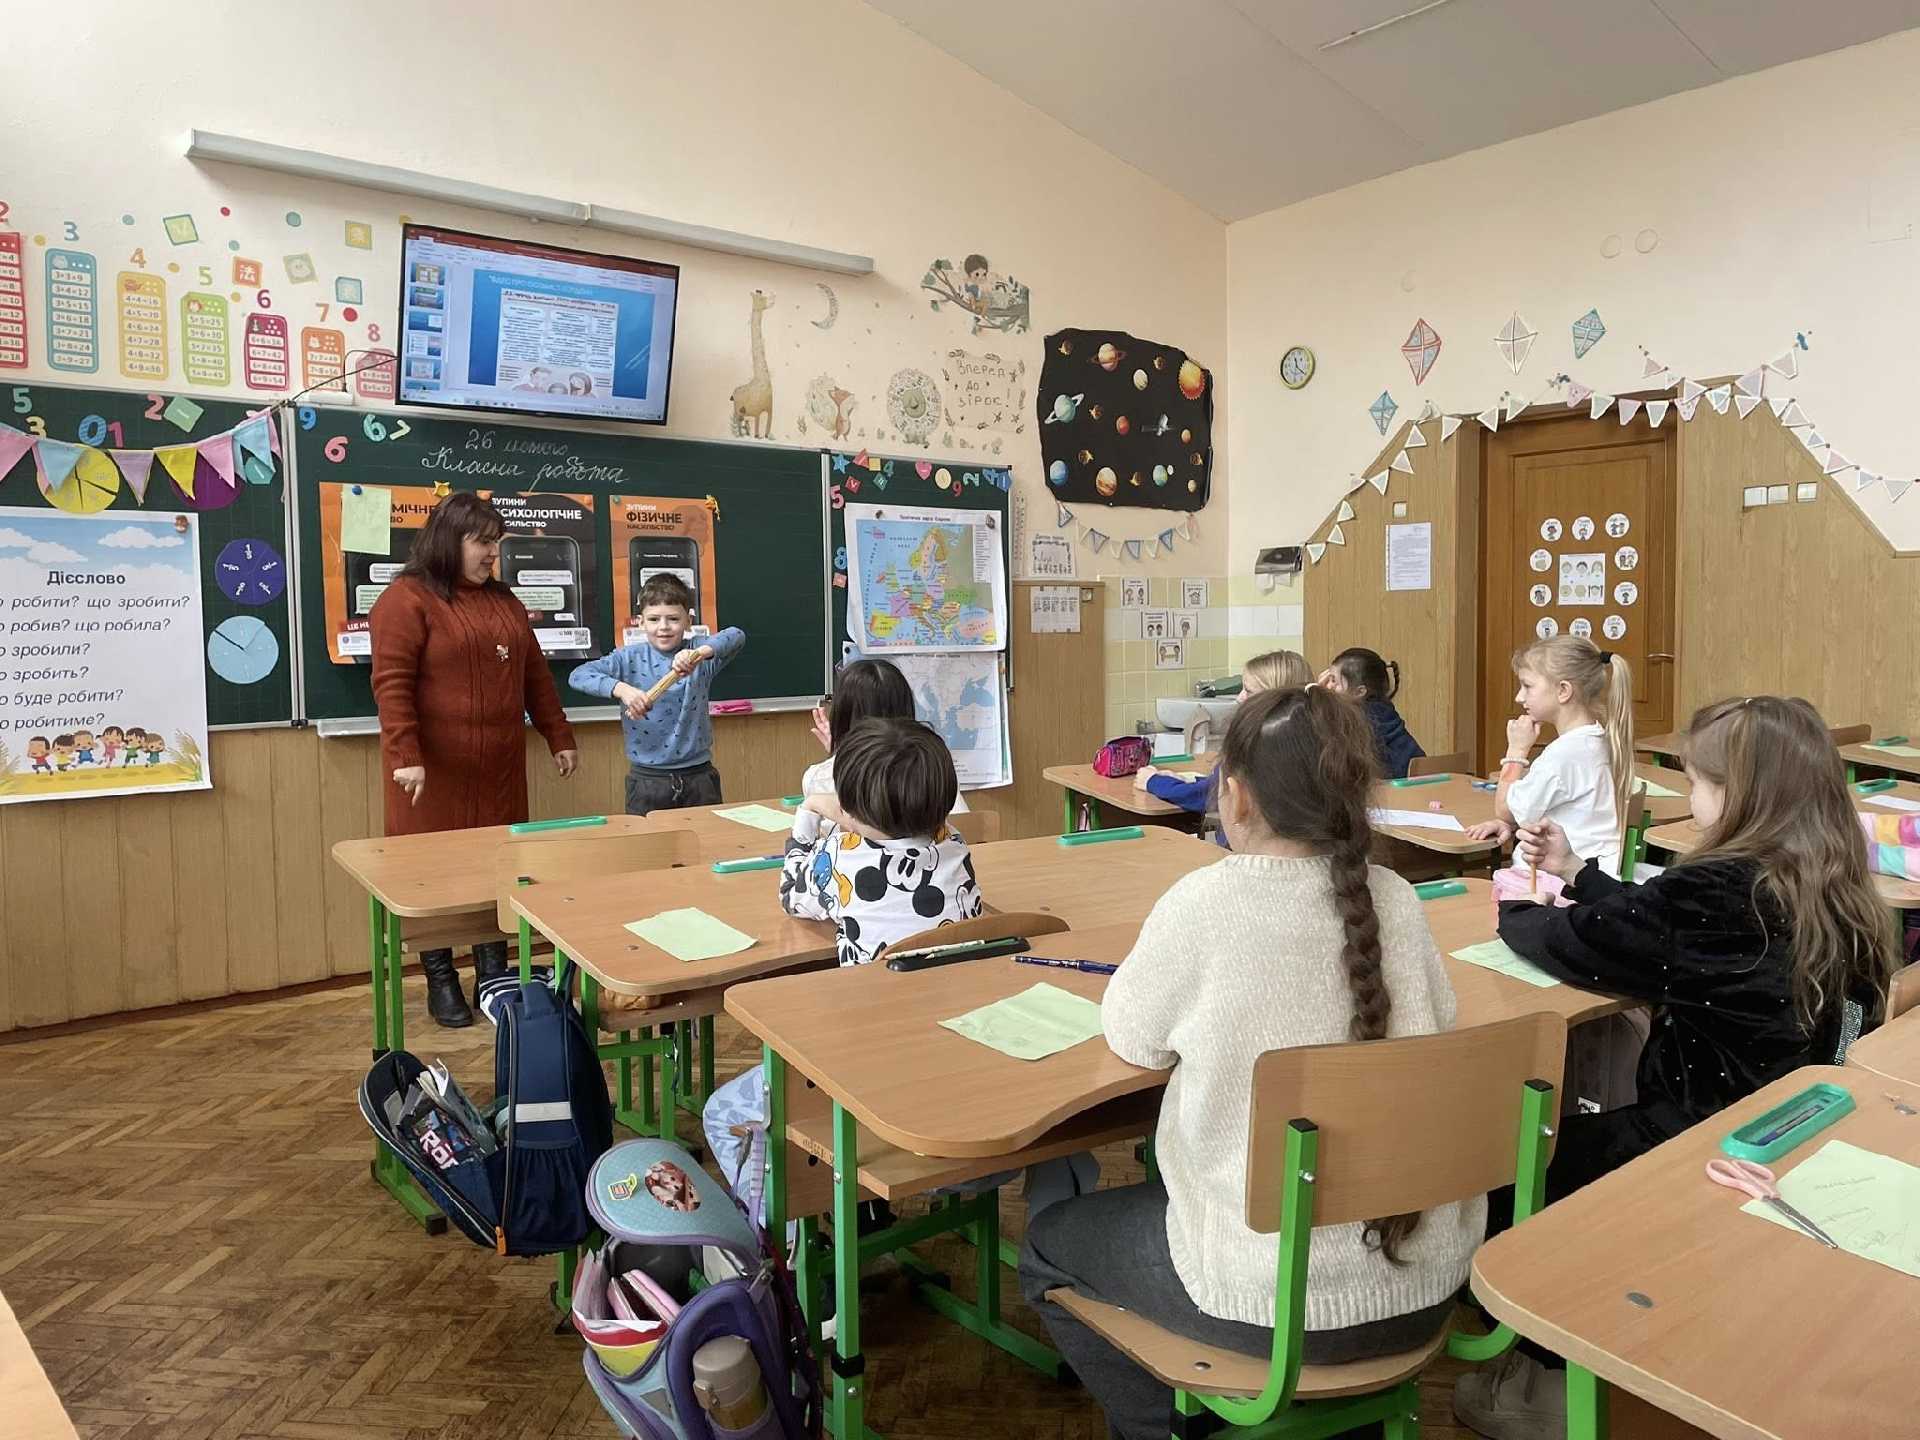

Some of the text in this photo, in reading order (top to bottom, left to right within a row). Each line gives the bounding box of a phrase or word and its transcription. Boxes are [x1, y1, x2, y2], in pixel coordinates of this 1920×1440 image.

[63, 221, 79, 241] 3
[130, 247, 146, 269] 4
[198, 265, 213, 286] 5
[257, 289, 272, 308] 6
[316, 302, 330, 322] 7
[367, 323, 381, 342] 8
[13, 388, 33, 413] 5
[145, 394, 165, 421] 2
[25, 416, 47, 440] 3
[299, 406, 317, 430] 9
[324, 435, 349, 463] 6
[465, 428, 496, 450] 26
[421, 447, 629, 493] Класна робота
[830, 485, 845, 509] 5
[626, 511, 683, 524] ФІЗИЧНЕ
[834, 547, 848, 570] 8
[47, 571, 126, 586] Дієслово
[12, 596, 80, 613] робити?
[87, 598, 111, 610] що
[118, 596, 190, 611] зробити?
[11, 619, 70, 635] робив?
[75, 620, 100, 633] що
[105, 618, 171, 633] робила?
[12, 643, 90, 660] зробили?
[13, 666, 89, 683] зробить?
[14, 692, 53, 707] буде
[58, 689, 124, 706] робити?
[15, 713, 105, 732] робитиме?
